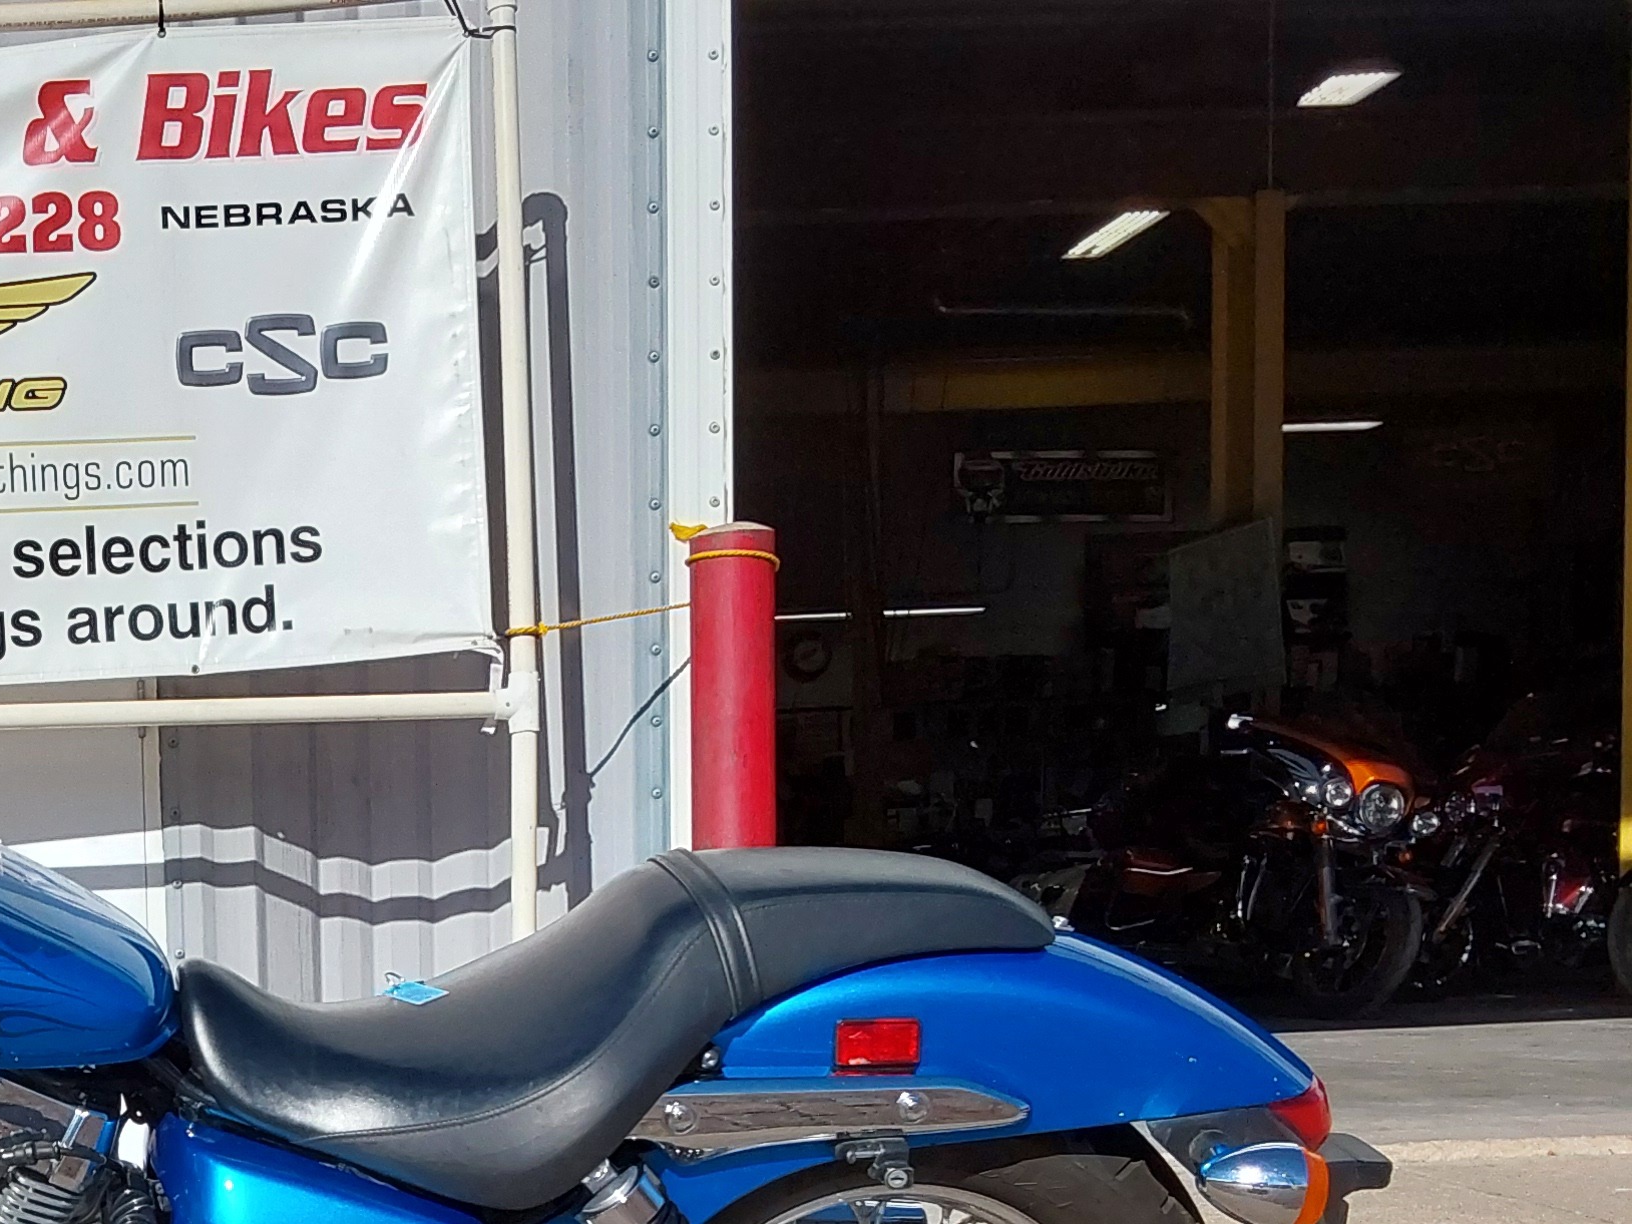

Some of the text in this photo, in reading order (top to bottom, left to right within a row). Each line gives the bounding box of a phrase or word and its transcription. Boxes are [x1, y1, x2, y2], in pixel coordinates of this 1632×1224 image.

[22, 79, 98, 166] &
[136, 68, 429, 163] Bikes
[161, 192, 415, 230] NEBRASKA
[176, 313, 389, 396] CSC
[13, 520, 324, 578] selections
[68, 584, 294, 643] around.
